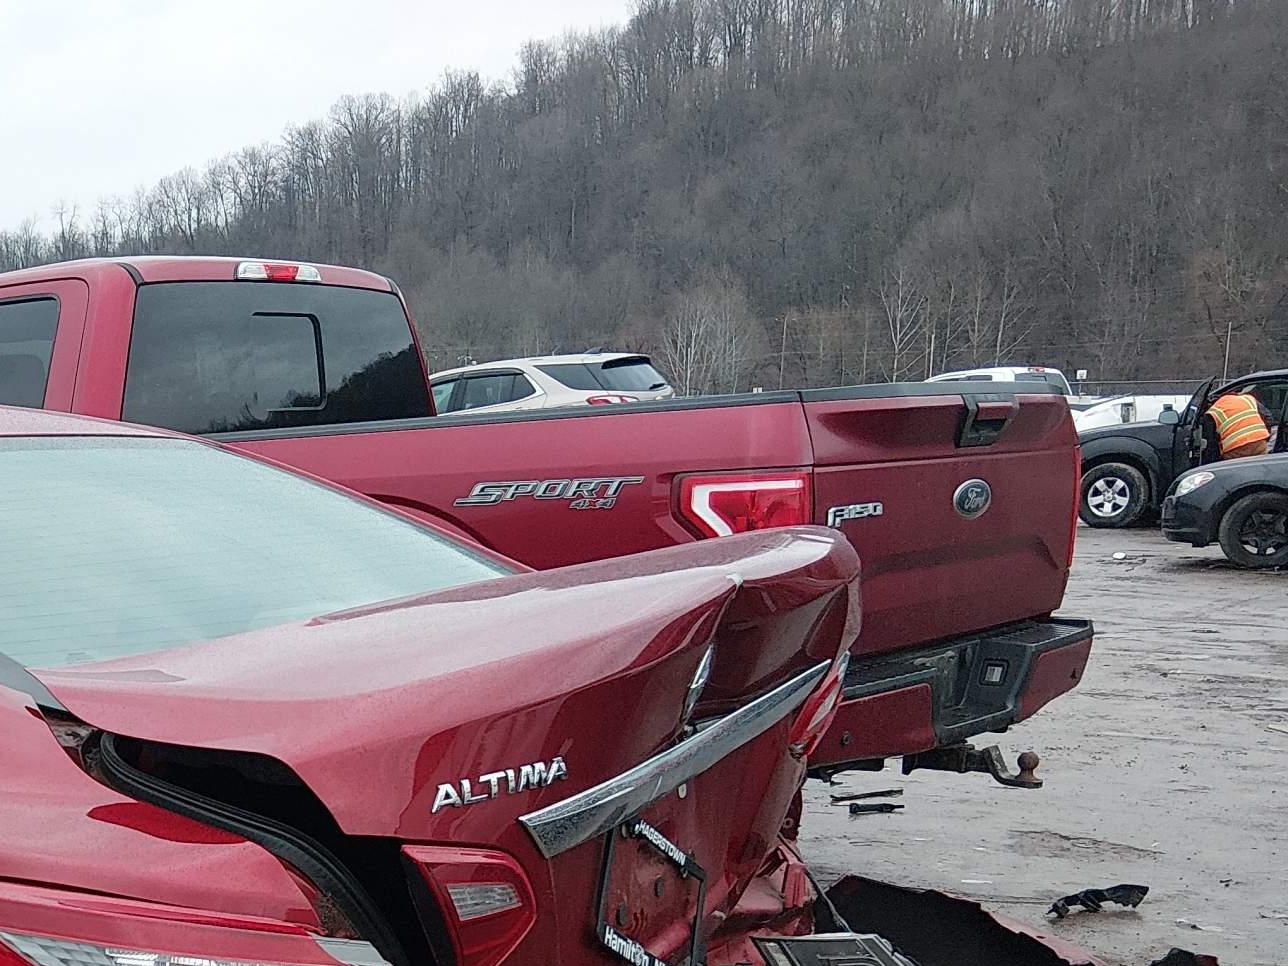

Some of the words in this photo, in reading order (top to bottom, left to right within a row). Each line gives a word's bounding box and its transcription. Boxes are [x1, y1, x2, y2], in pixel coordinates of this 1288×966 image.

[453, 475, 645, 506] SPORT
[432, 756, 568, 813] ALTIMA
[638, 819, 686, 867] HAGERSTOWN
